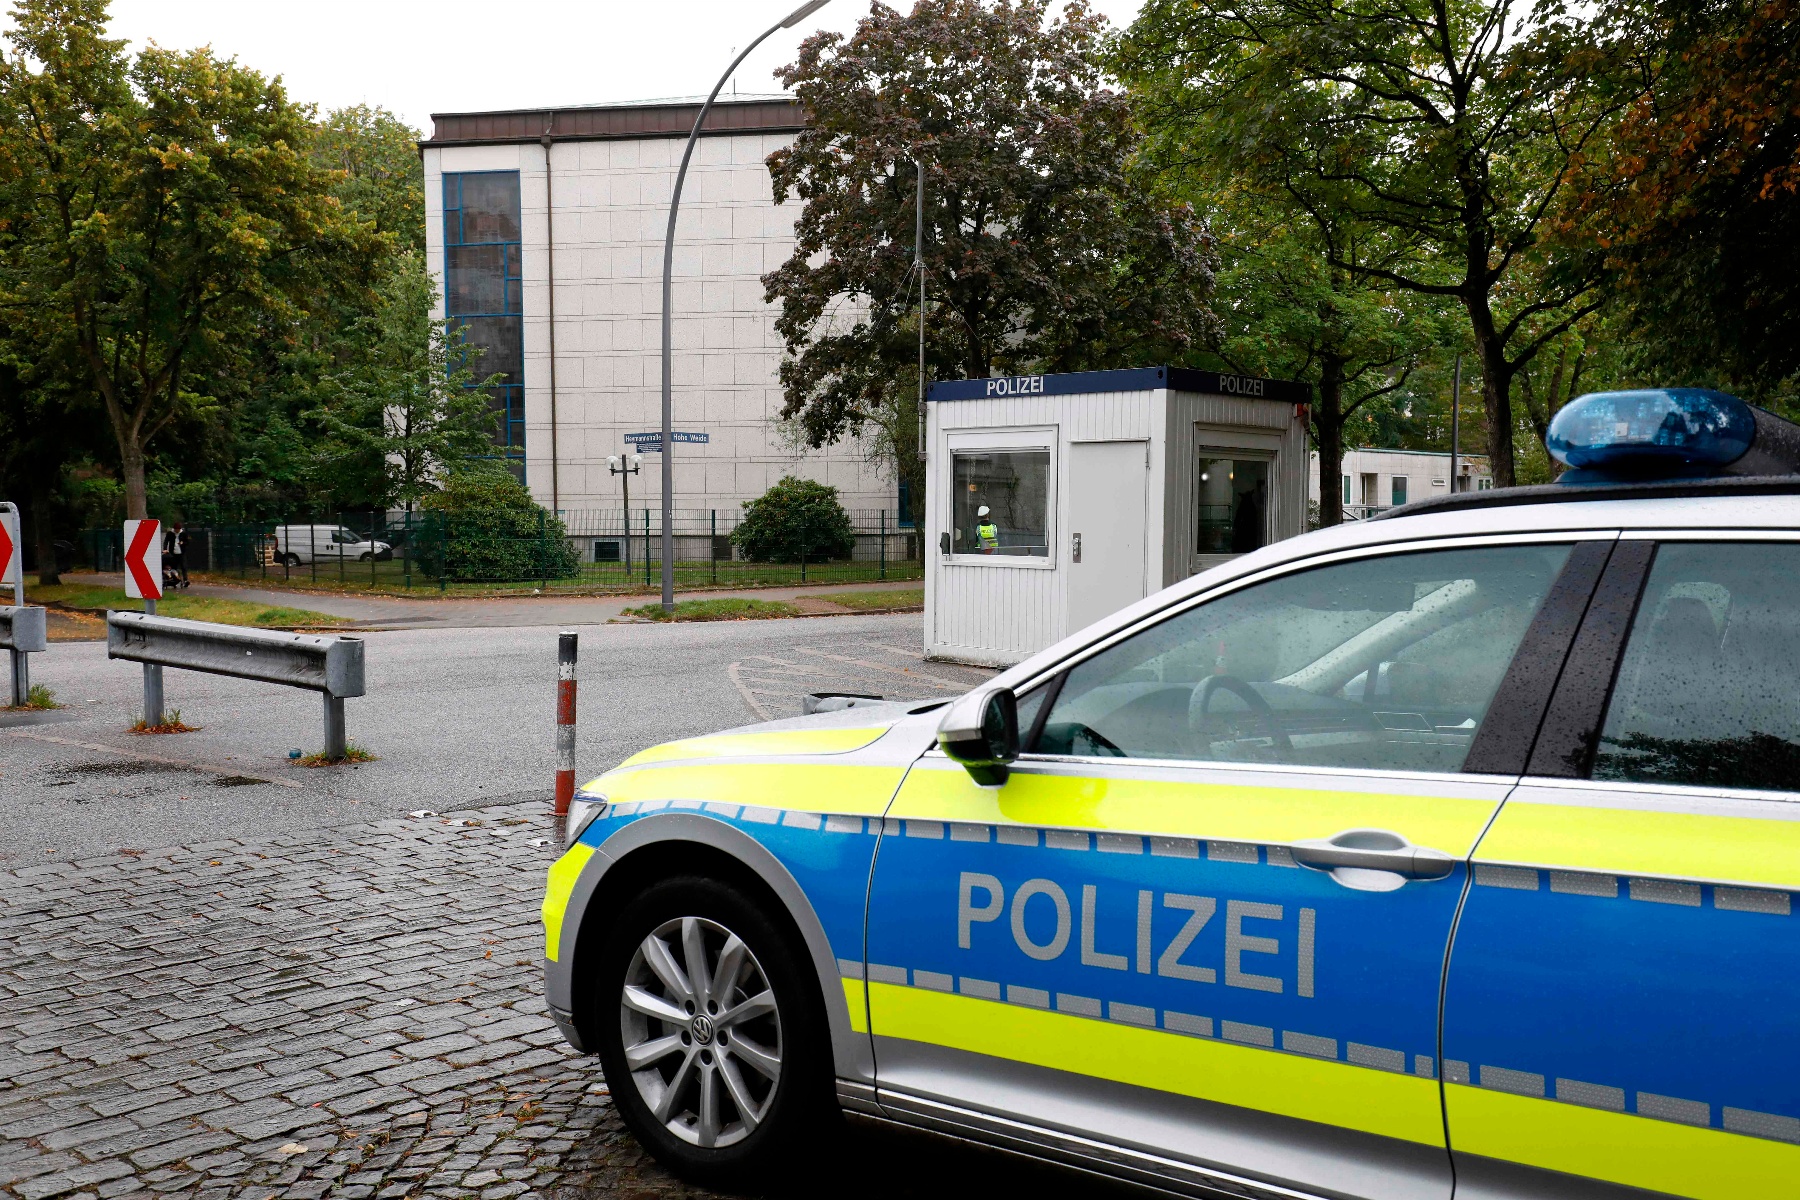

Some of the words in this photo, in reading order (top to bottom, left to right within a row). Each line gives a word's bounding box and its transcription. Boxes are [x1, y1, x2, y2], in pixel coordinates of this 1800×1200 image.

[986, 375, 1045, 396] POLIZEI
[1219, 375, 1264, 397] POLIZEI
[673, 433, 688, 441] Hohe
[689, 434, 707, 442] Weide
[957, 871, 1316, 999] POLIZEI
